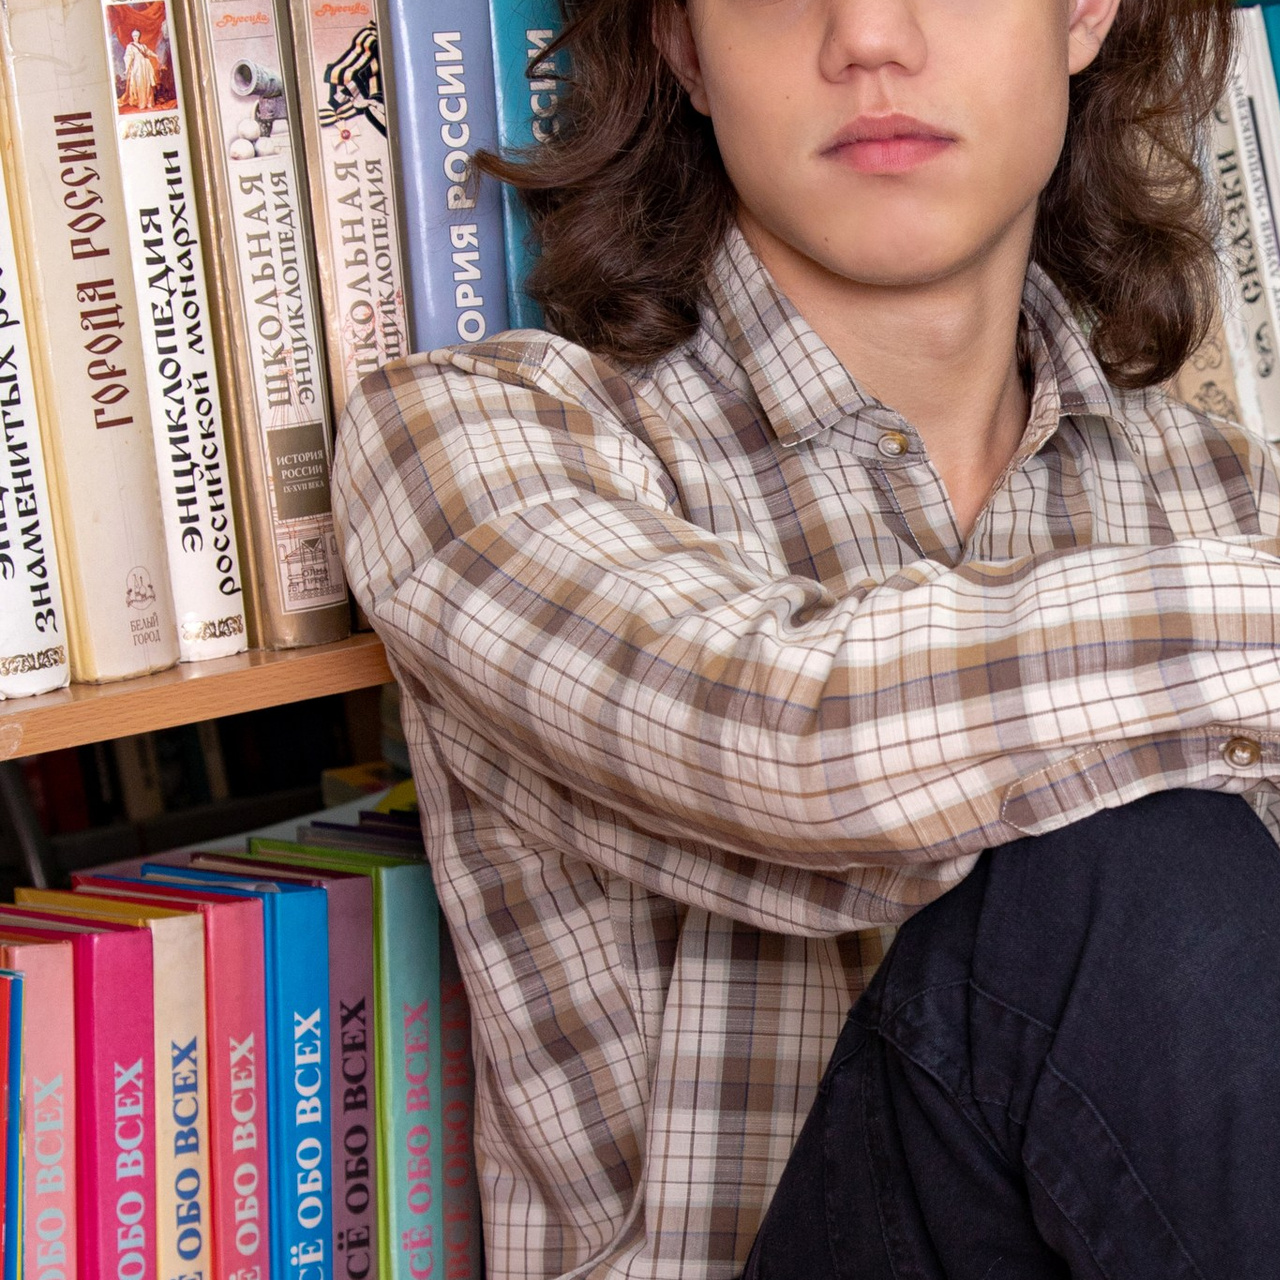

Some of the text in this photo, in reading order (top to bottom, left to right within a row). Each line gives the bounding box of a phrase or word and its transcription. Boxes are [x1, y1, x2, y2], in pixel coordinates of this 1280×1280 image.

[432, 29, 485, 342] ОРИЯ РОССИИ
[1214, 148, 1264, 303] СКАЗКИ
[52, 110, 133, 431] ГОРОДА РОССИИ
[237, 171, 293, 408] ШКОЛЬНАЯ
[268, 170, 315, 405] ЭНЦИКЛОПЕДИЯ
[363, 158, 408, 362] НЦИКЛОПЕДИЯ
[137, 206, 204, 553] ЭНЦИКЛОПЕДИЯ
[276, 450, 324, 467] ИСТОРИЯ
[281, 464, 323, 480] РОССИИ
[130, 612, 160, 633] БЕЛЫЙ
[133, 629, 162, 647] ГОРОД
[170, 1036, 200, 1156] ВСЕХ
[228, 1032, 257, 1153] ВСЕХ
[292, 1007, 321, 1127] ВСЕХ
[339, 996, 367, 1113] ВСЕХ
[402, 997, 431, 1113] ВСЕХ
[32, 1073, 66, 1196] ВСЕХ
[113, 1058, 145, 1181] ВСЕХ
[342, 1124, 369, 1215] ОБО
[406, 1126, 434, 1215] ОБО
[172, 1168, 203, 1260] ОБО
[233, 1165, 261, 1255] ОБО
[296, 1138, 324, 1229] ОБО
